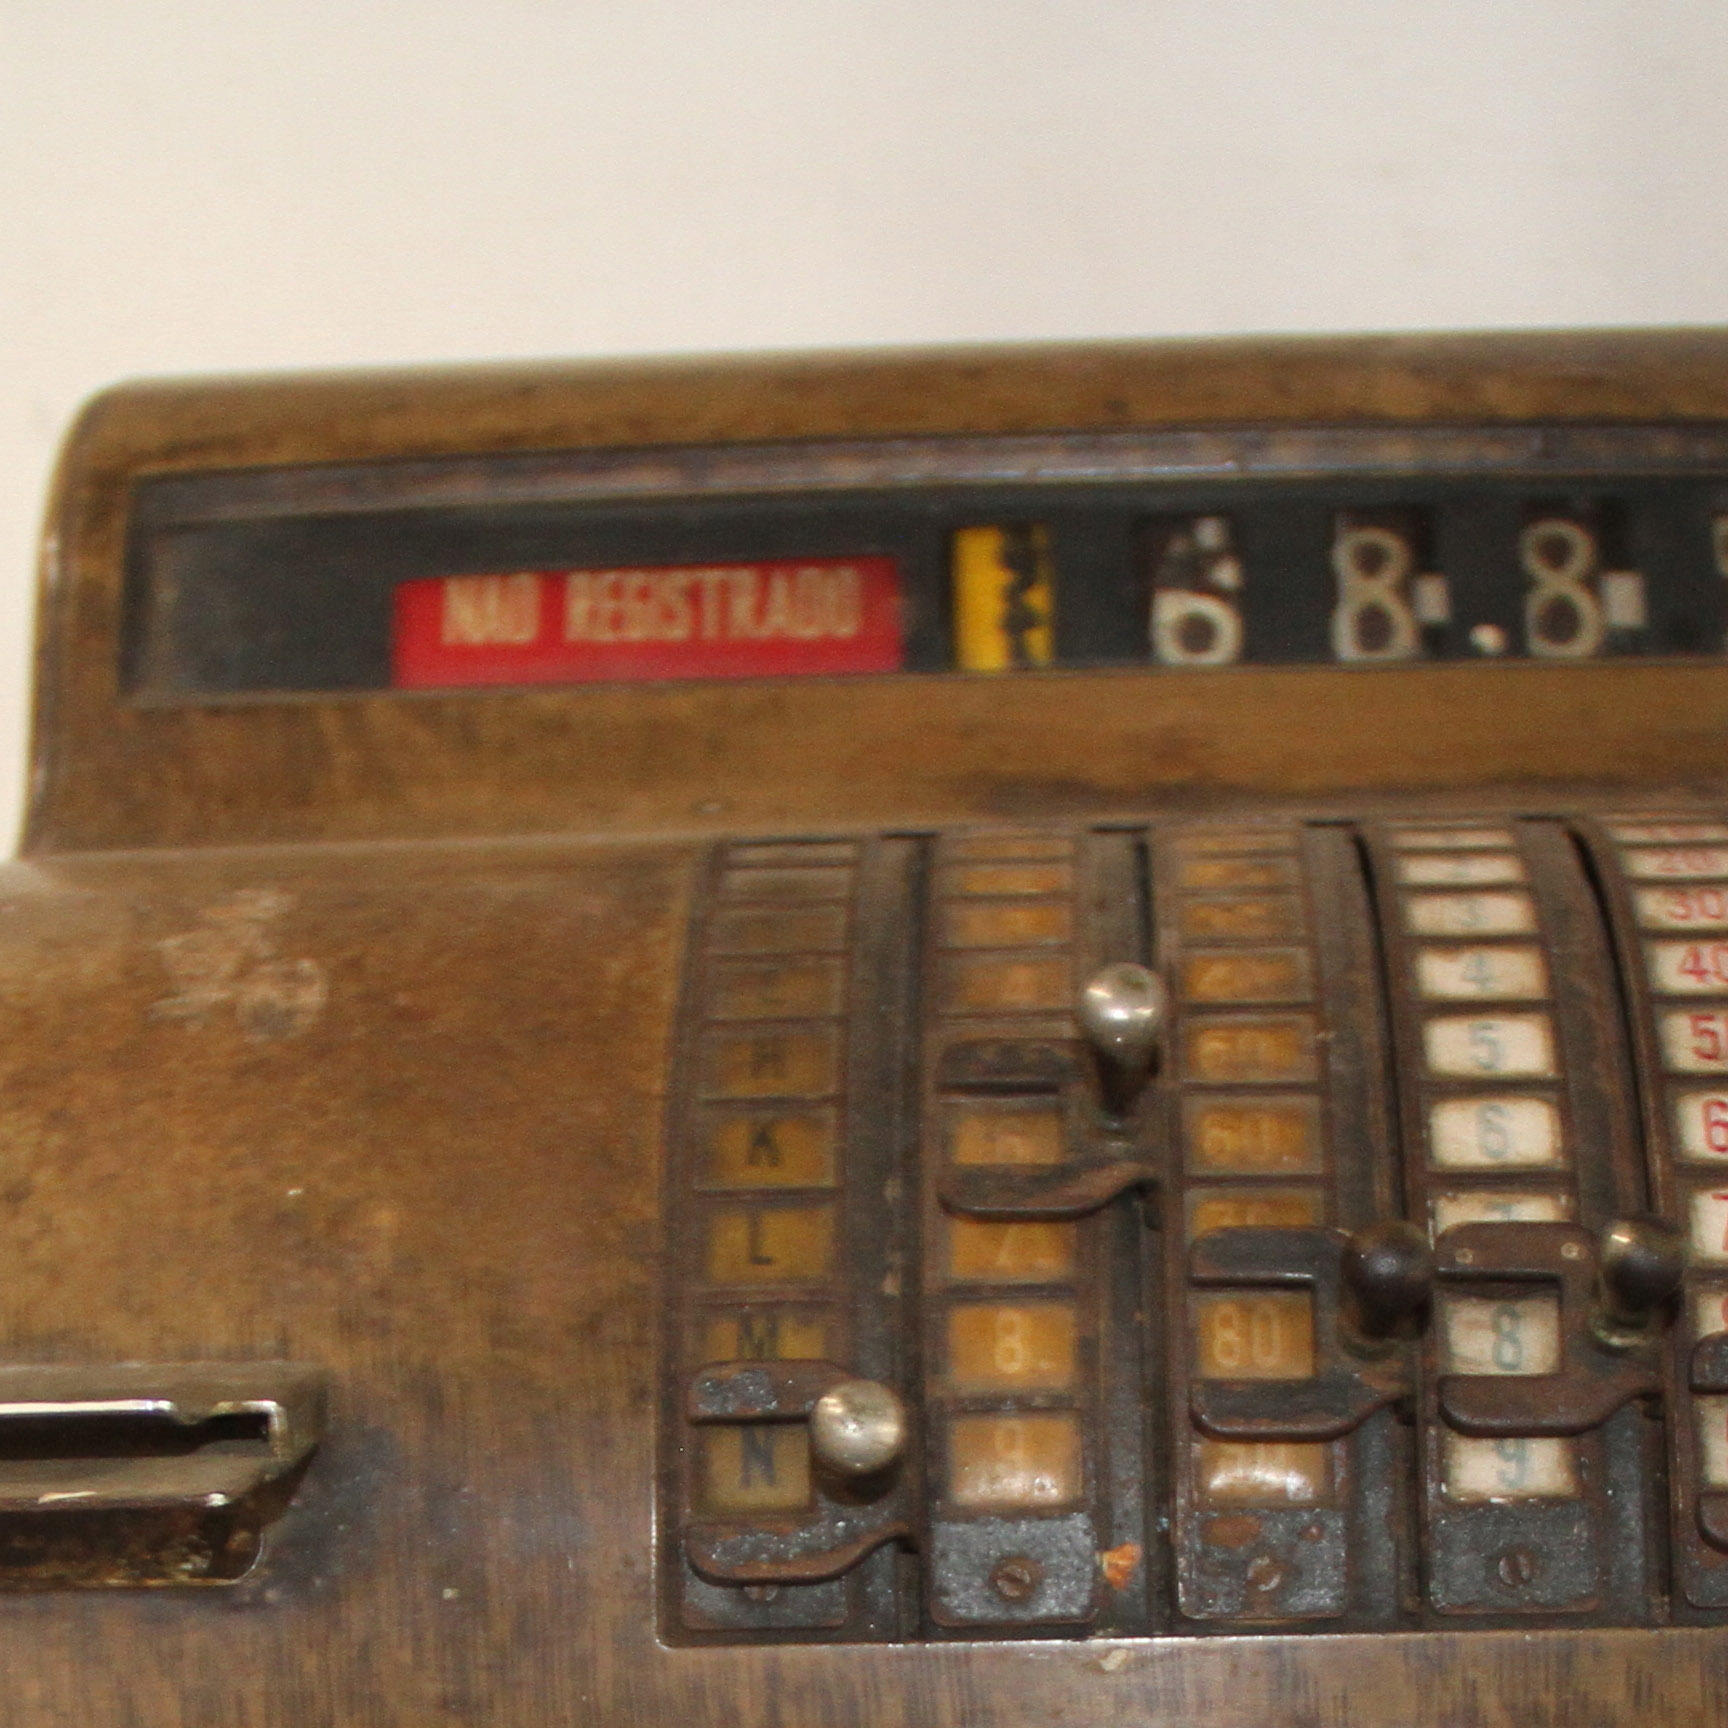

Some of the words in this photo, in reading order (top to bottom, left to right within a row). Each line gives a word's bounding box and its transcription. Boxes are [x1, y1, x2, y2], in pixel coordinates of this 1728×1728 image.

[1665, 888, 1727, 921] 30
[1212, 1307, 1284, 1367] 80
[1489, 1305, 1521, 1371] 8
